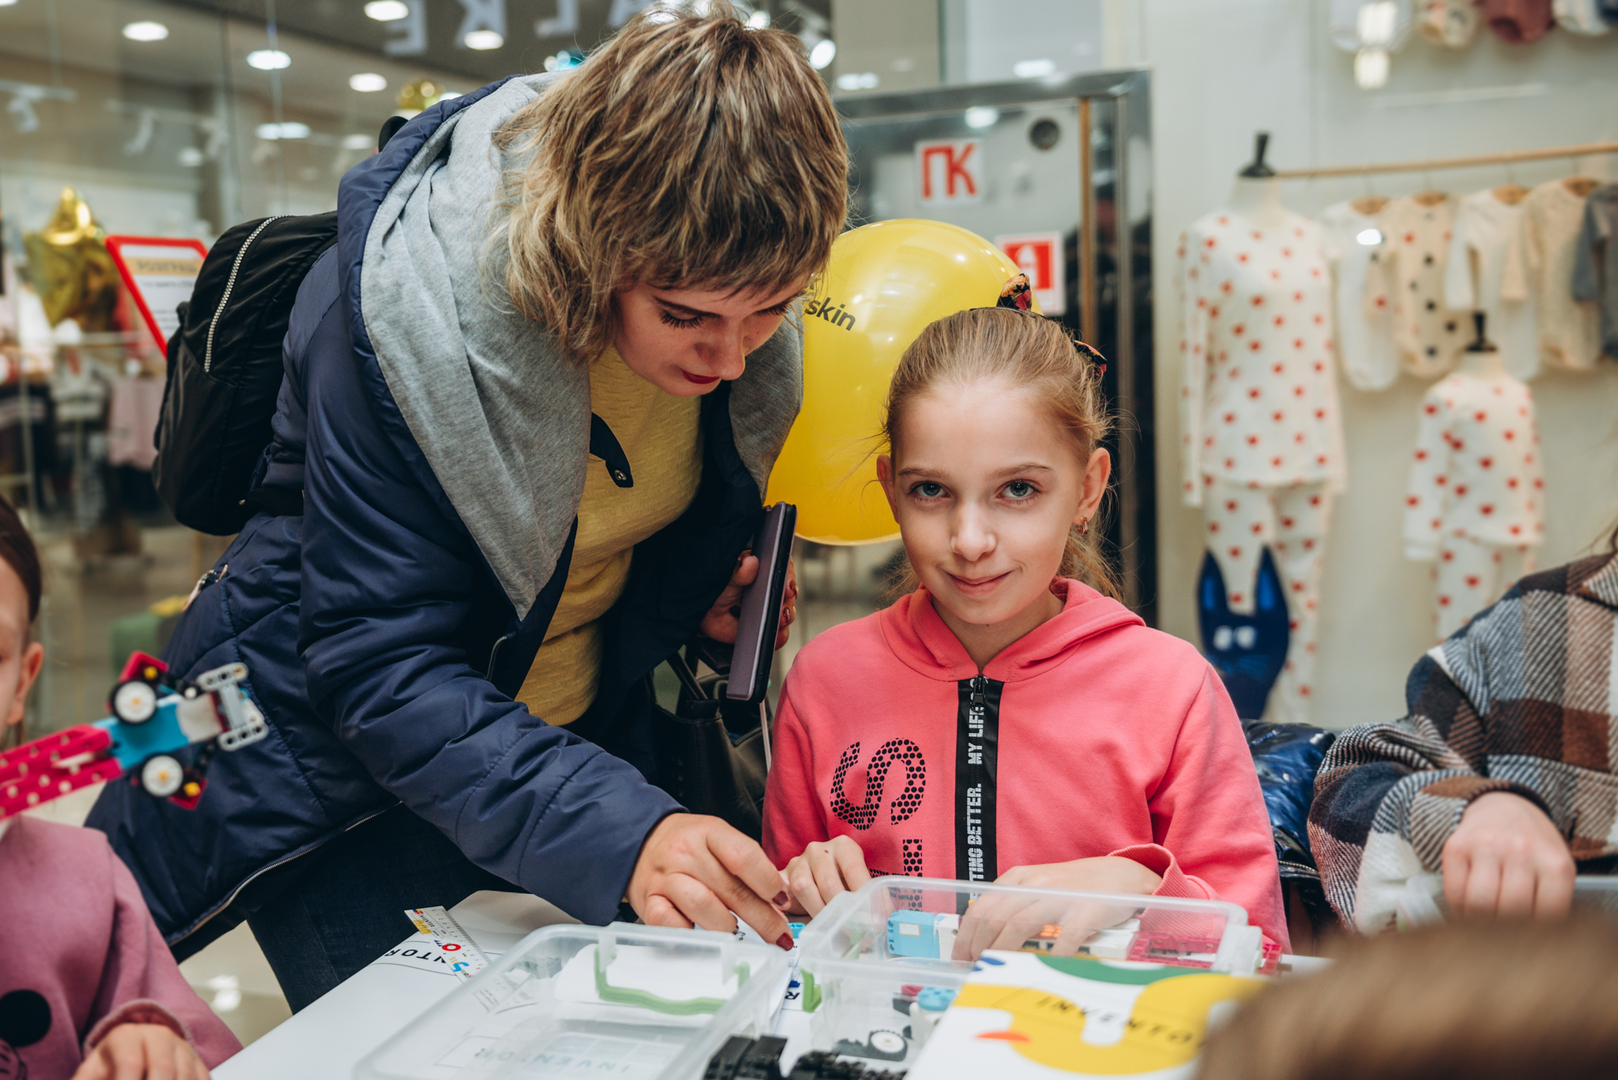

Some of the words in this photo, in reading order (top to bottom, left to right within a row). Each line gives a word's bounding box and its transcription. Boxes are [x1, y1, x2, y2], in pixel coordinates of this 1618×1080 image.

[922, 143, 977, 198] ПК
[805, 297, 856, 331] skin
[967, 742, 983, 765] MY
[966, 783, 984, 846] BETTER.
[1035, 995, 1202, 1047] INVENTO
